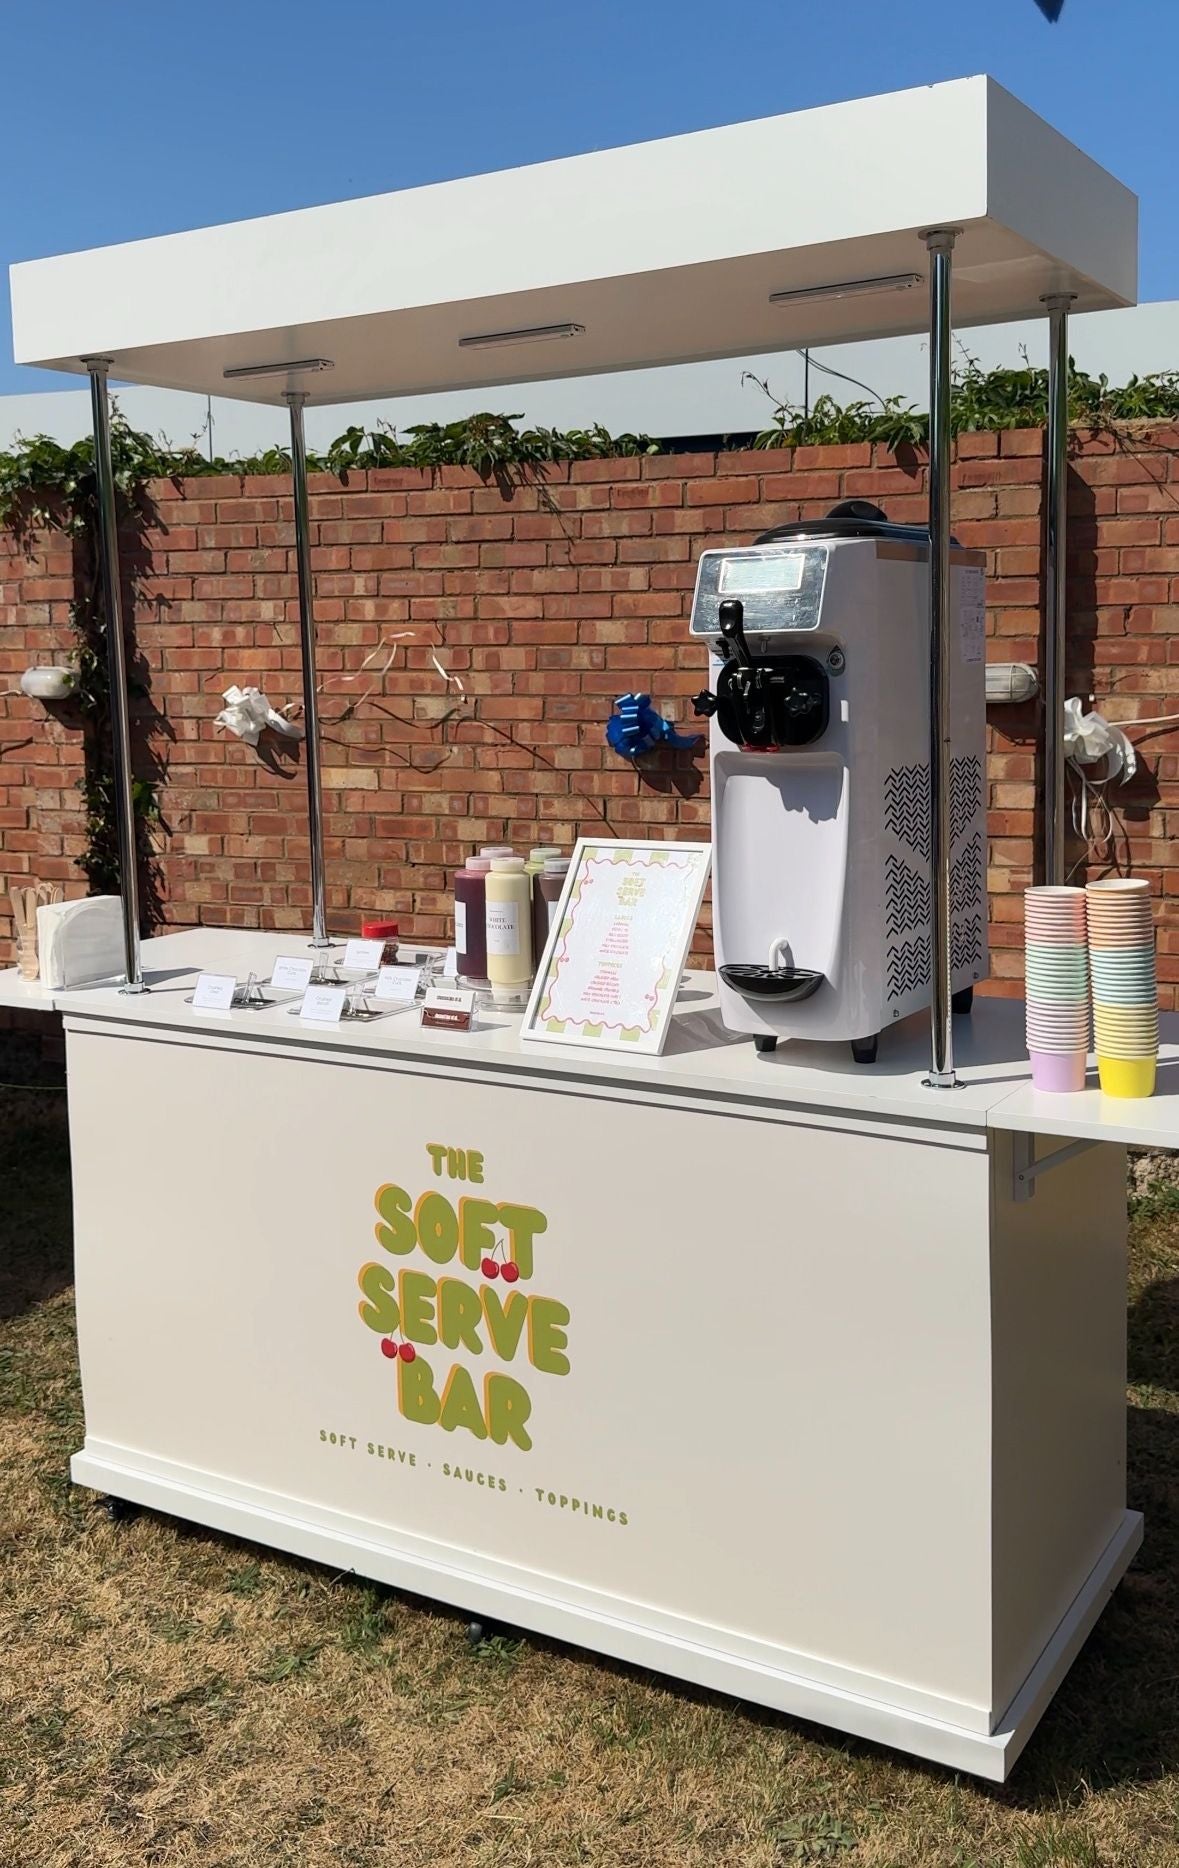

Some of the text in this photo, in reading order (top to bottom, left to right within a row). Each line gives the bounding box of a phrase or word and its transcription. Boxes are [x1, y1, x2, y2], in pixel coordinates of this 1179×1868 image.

[426, 1143, 484, 1184] THE
[374, 1183, 548, 1280] SOFT
[357, 1262, 571, 1376] SERVE
[396, 1355, 533, 1451] BAR
[319, 1429, 629, 1526] SOFT SERVE SAUCES TOPPINGS
